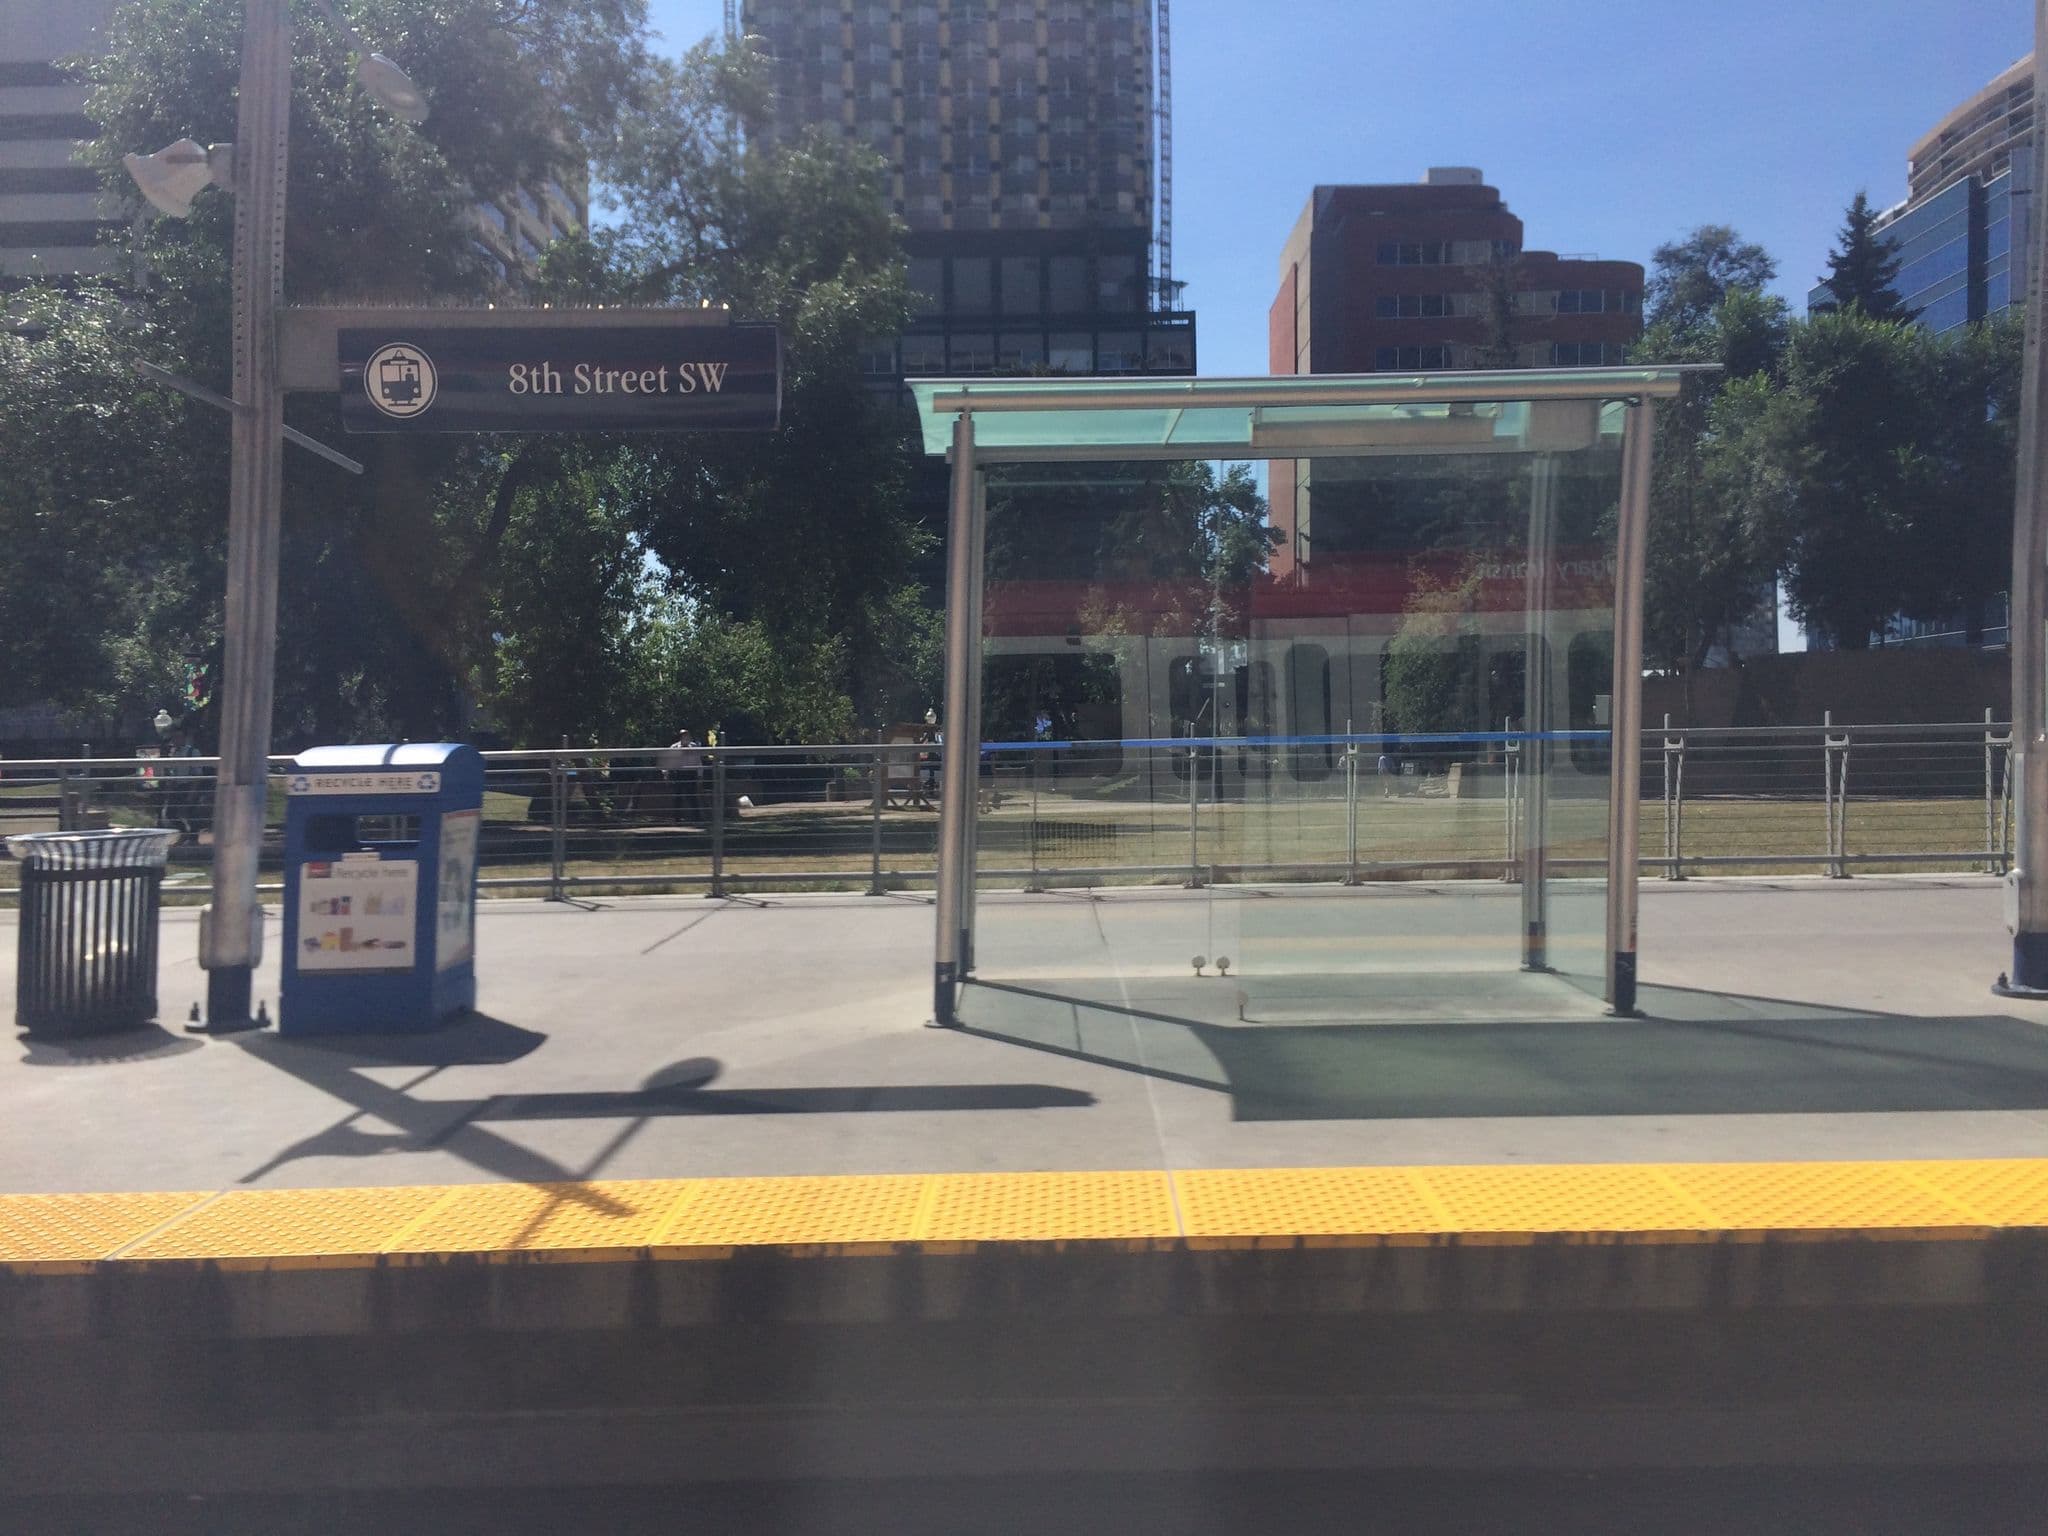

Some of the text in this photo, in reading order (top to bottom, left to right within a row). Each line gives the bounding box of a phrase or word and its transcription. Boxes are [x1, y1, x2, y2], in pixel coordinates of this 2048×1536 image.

[508, 361, 728, 394] 8th Street SW
[313, 775, 414, 788] RECYCLE HERE
